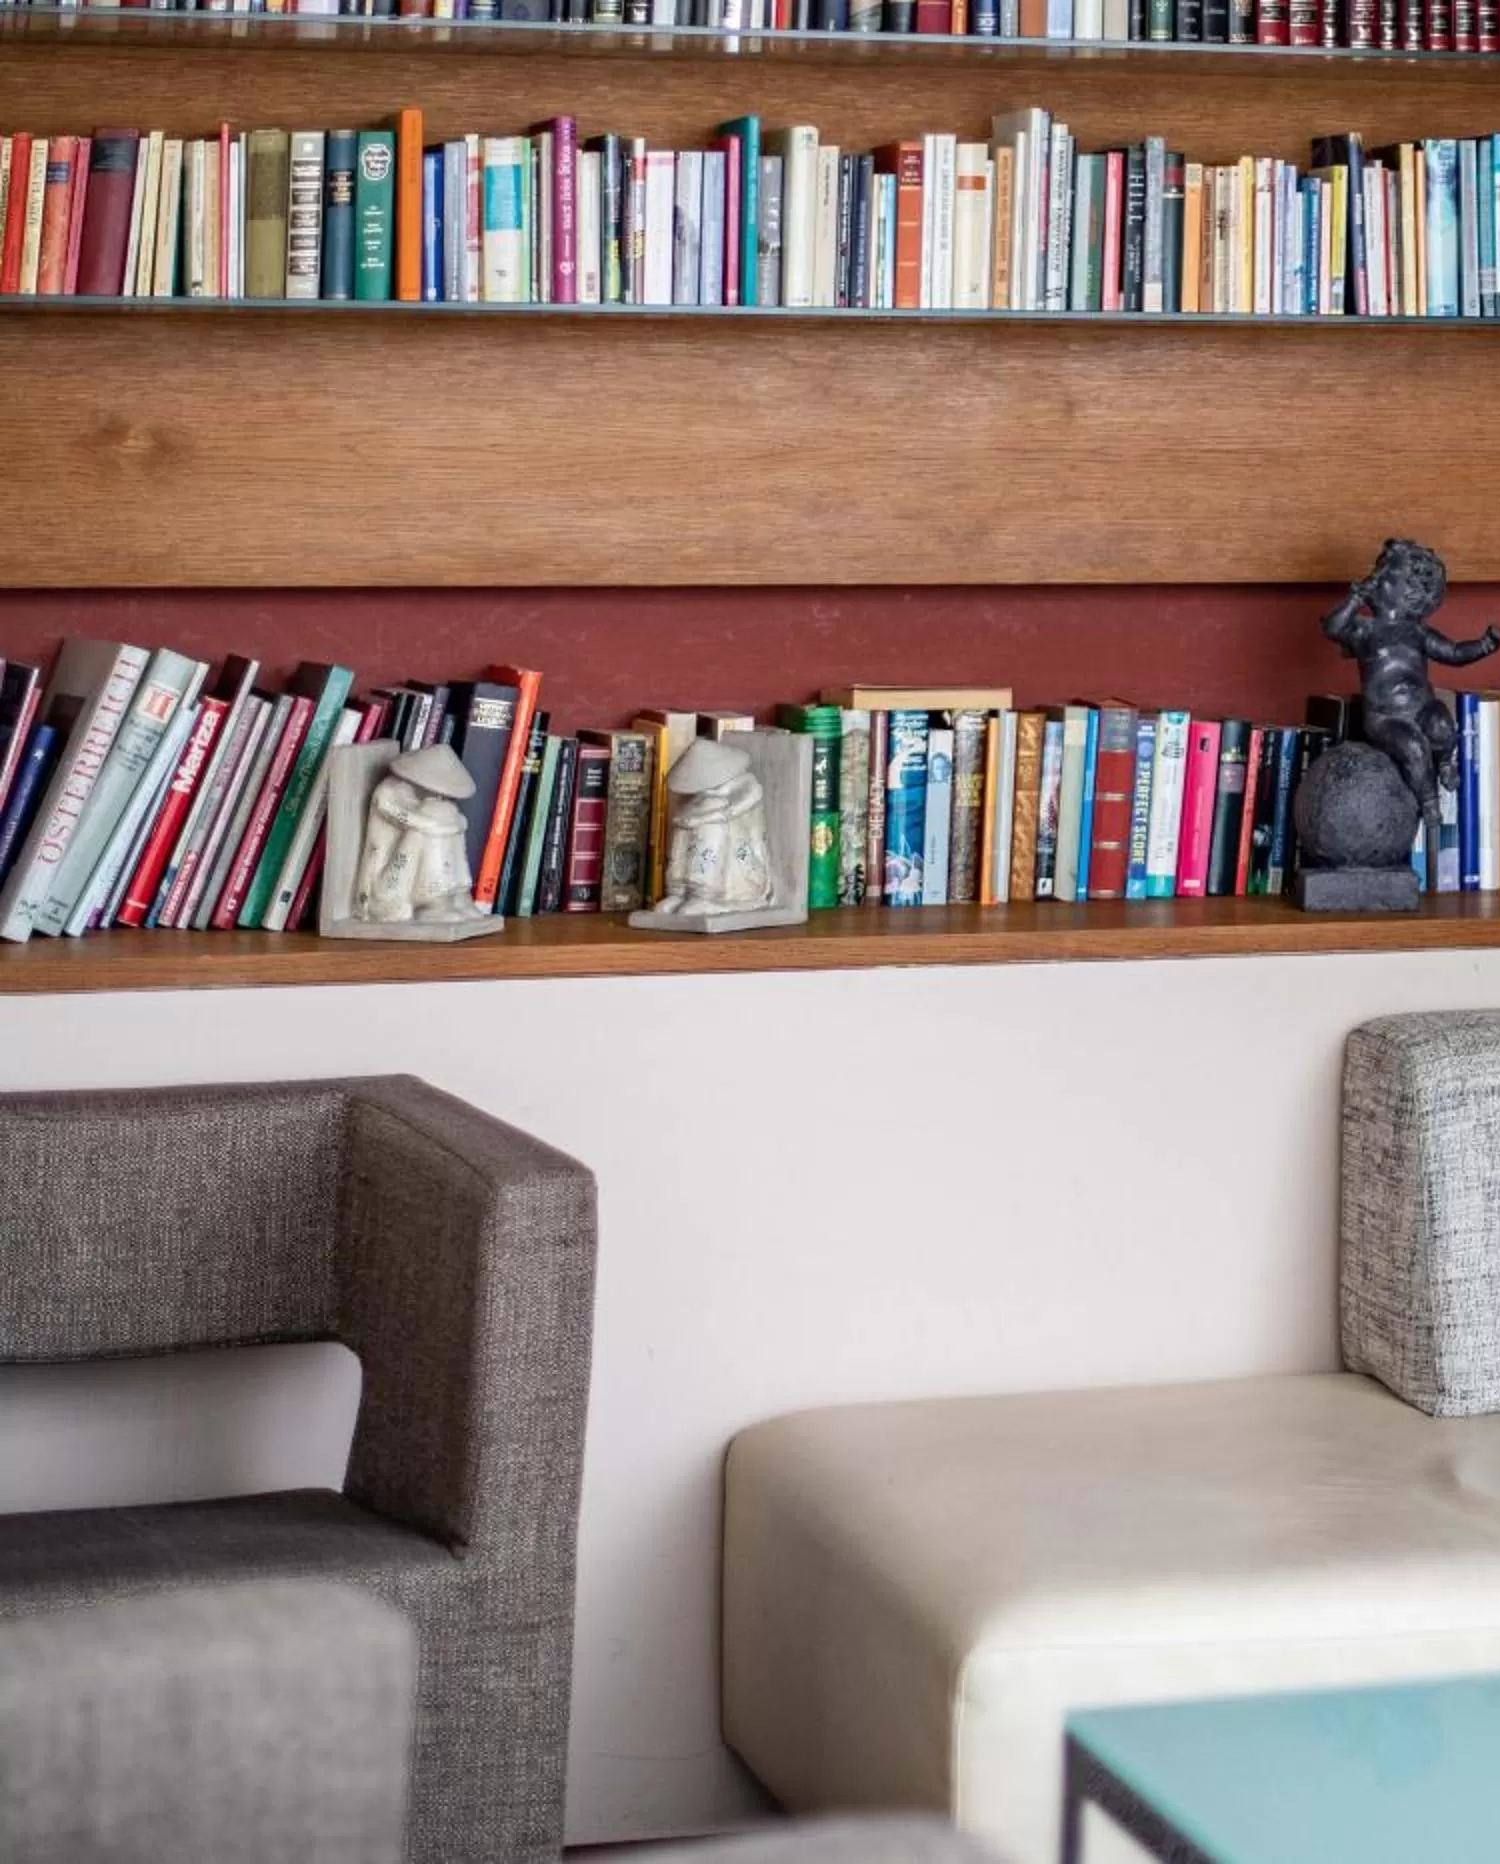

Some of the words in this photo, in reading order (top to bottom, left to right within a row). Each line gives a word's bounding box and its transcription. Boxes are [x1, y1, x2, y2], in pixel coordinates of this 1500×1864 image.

[38, 658, 141, 865] ÖSTERREICH
[172, 709, 221, 793] Mariza
[1136, 770, 1151, 821] PERFECT
[1132, 825, 1147, 865] SCORE
